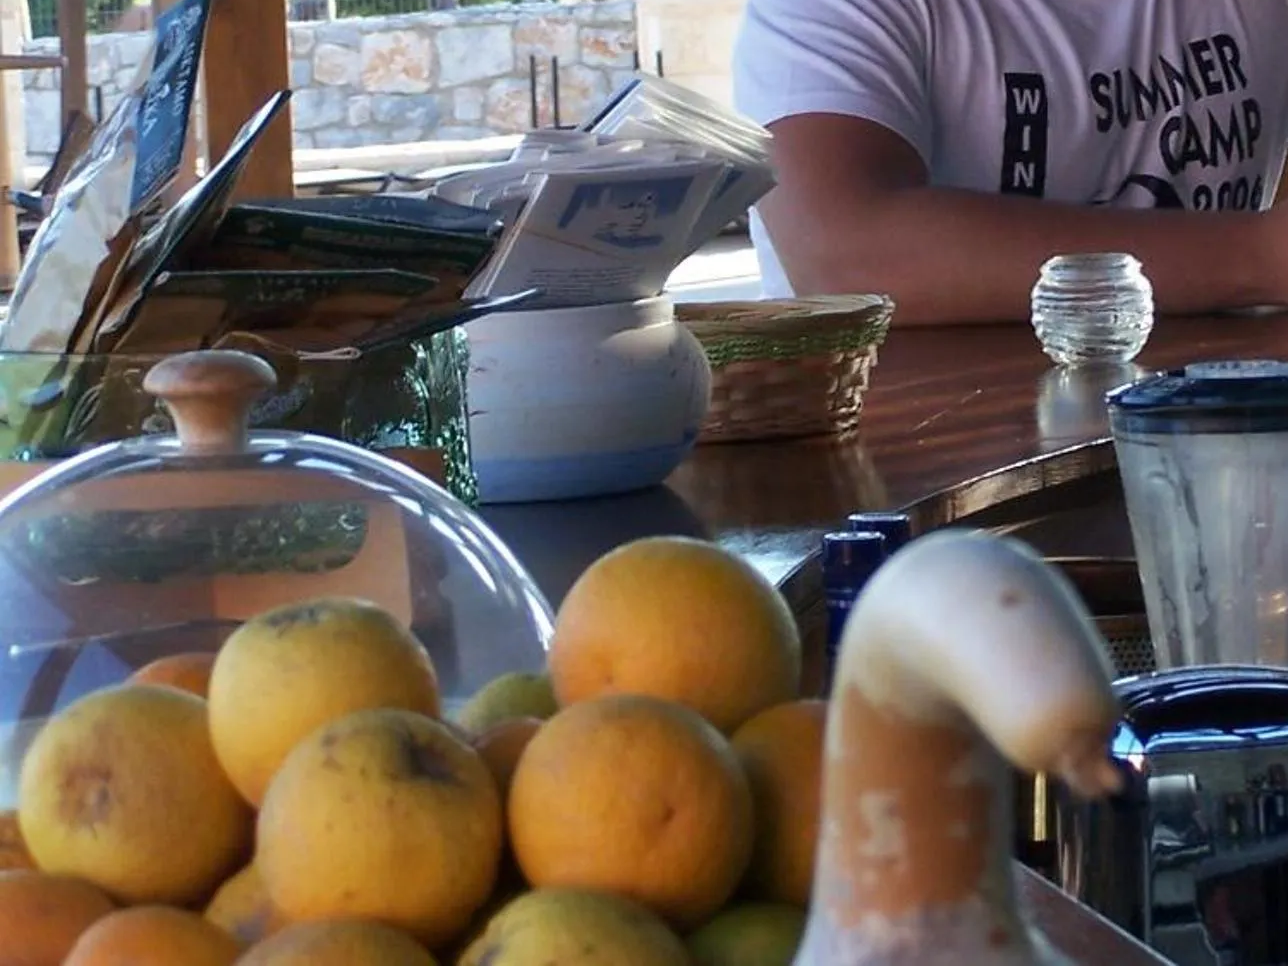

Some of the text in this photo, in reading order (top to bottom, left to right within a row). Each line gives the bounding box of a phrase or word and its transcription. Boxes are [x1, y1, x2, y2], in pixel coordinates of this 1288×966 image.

[1090, 34, 1247, 132] SUMMER
[1010, 86, 1041, 190] WIN
[1159, 99, 1261, 175] CAMP
